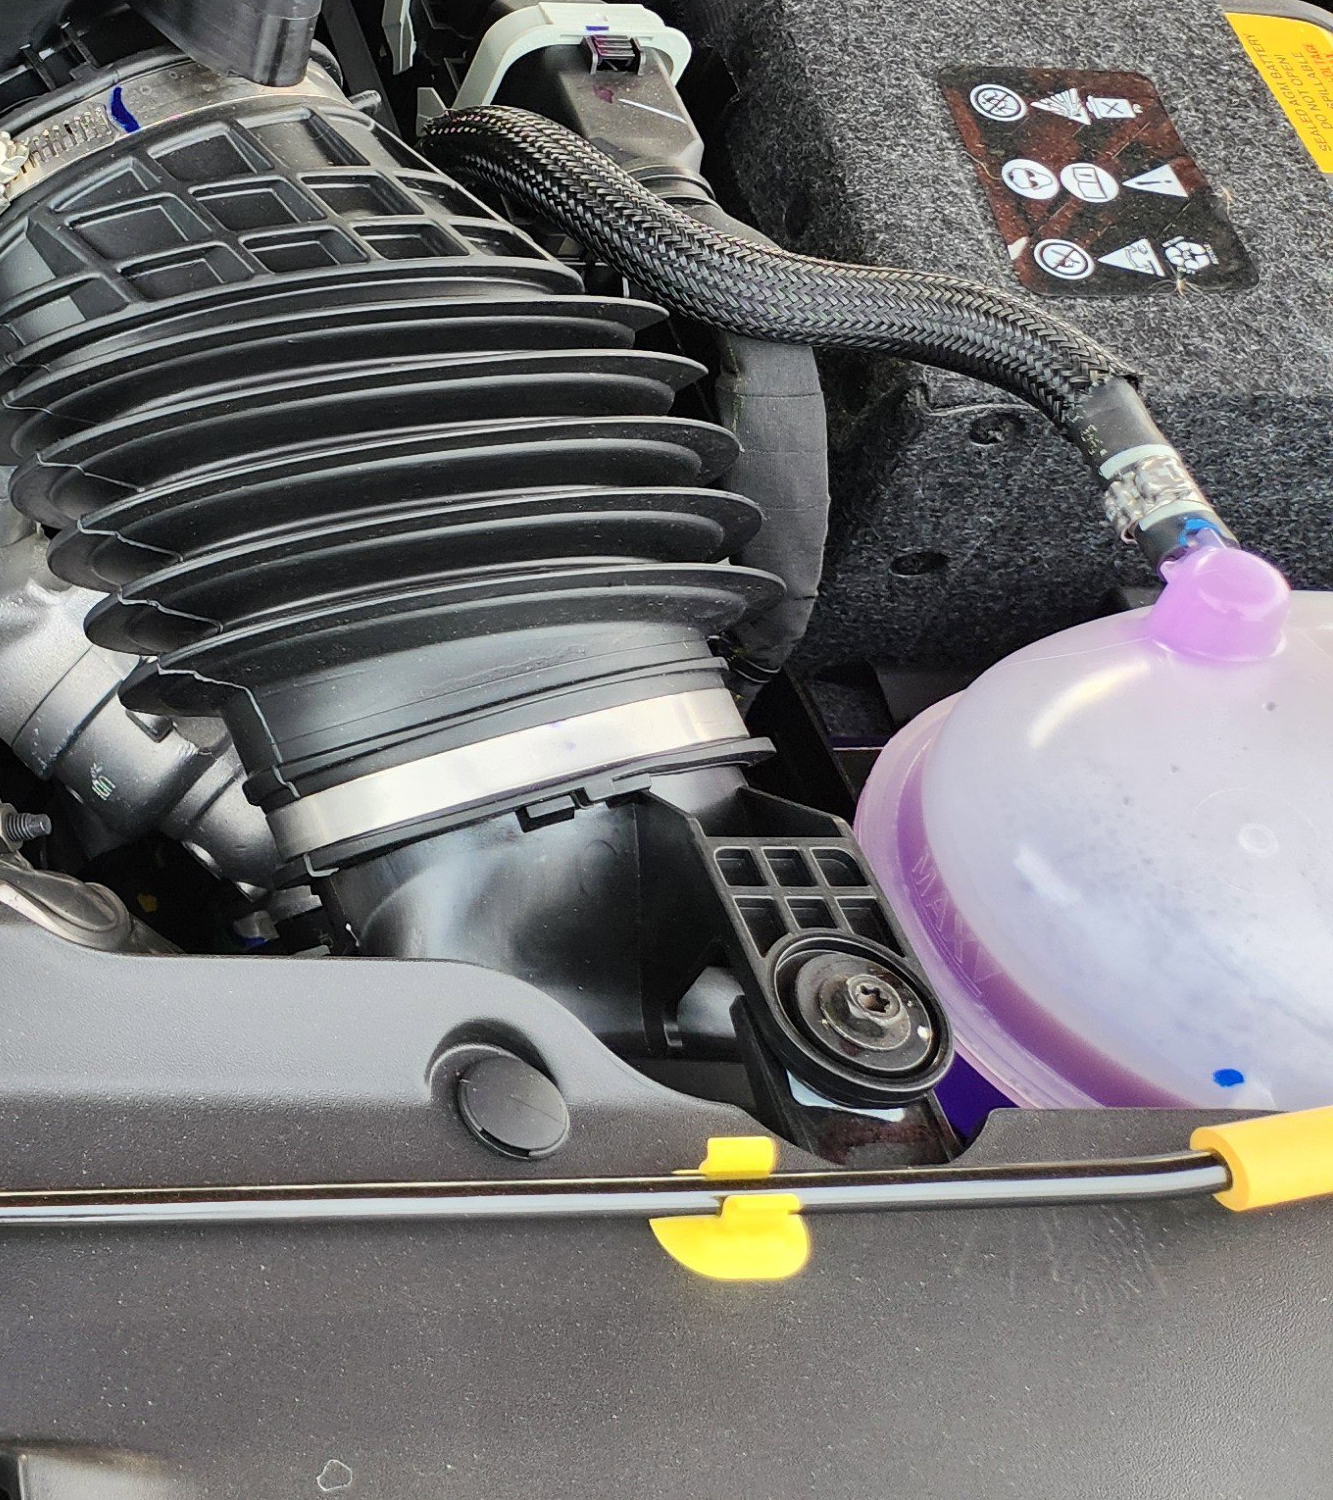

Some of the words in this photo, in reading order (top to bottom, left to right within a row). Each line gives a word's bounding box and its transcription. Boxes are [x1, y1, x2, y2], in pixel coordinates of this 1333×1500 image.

[1243, 33, 1282, 79] BATTERY
[1303, 91, 1321, 111] NOT
[1295, 108, 1332, 152] SEALED
[1314, 113, 1332, 129] DO
